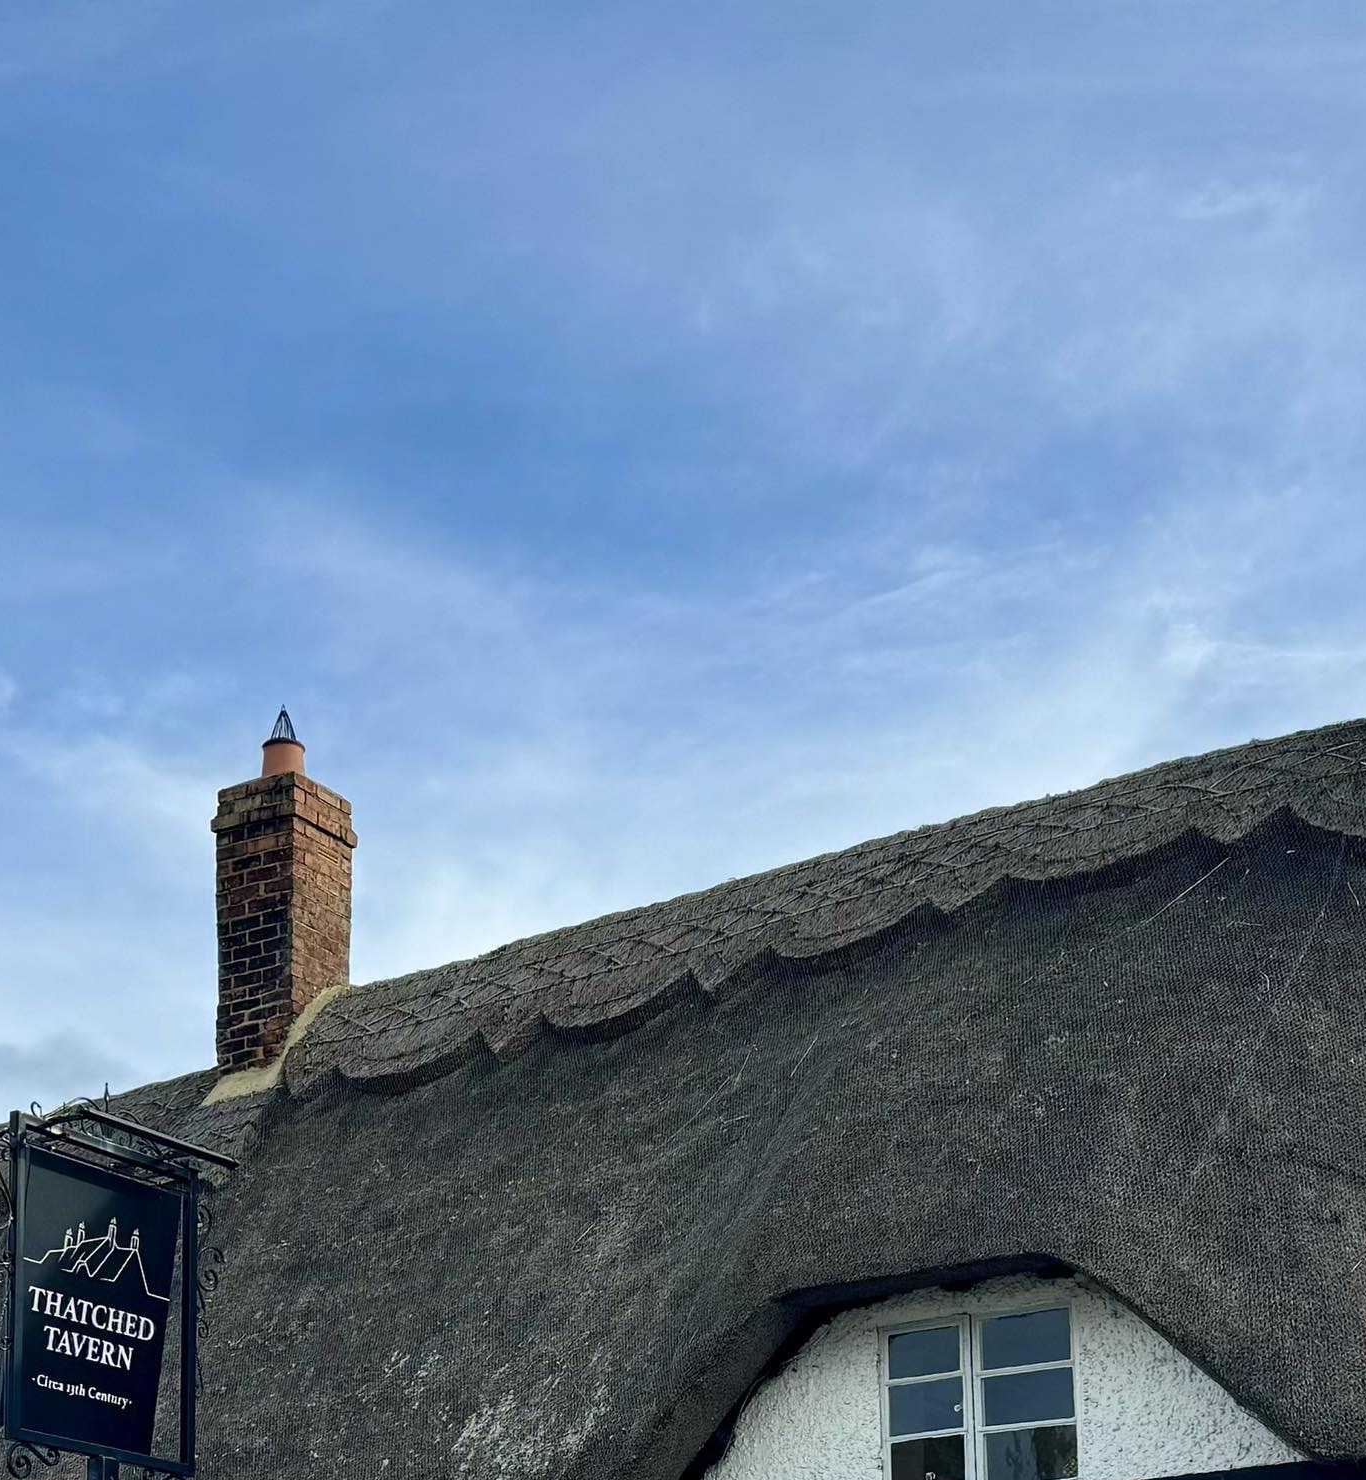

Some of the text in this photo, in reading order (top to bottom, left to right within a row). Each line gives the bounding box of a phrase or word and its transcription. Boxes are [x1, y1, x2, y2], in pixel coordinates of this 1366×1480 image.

[28, 1285, 155, 1341] THATCHED
[43, 1325, 134, 1371] TAVERN
[36, 1374, 129, 1410] Circa 13th Century
